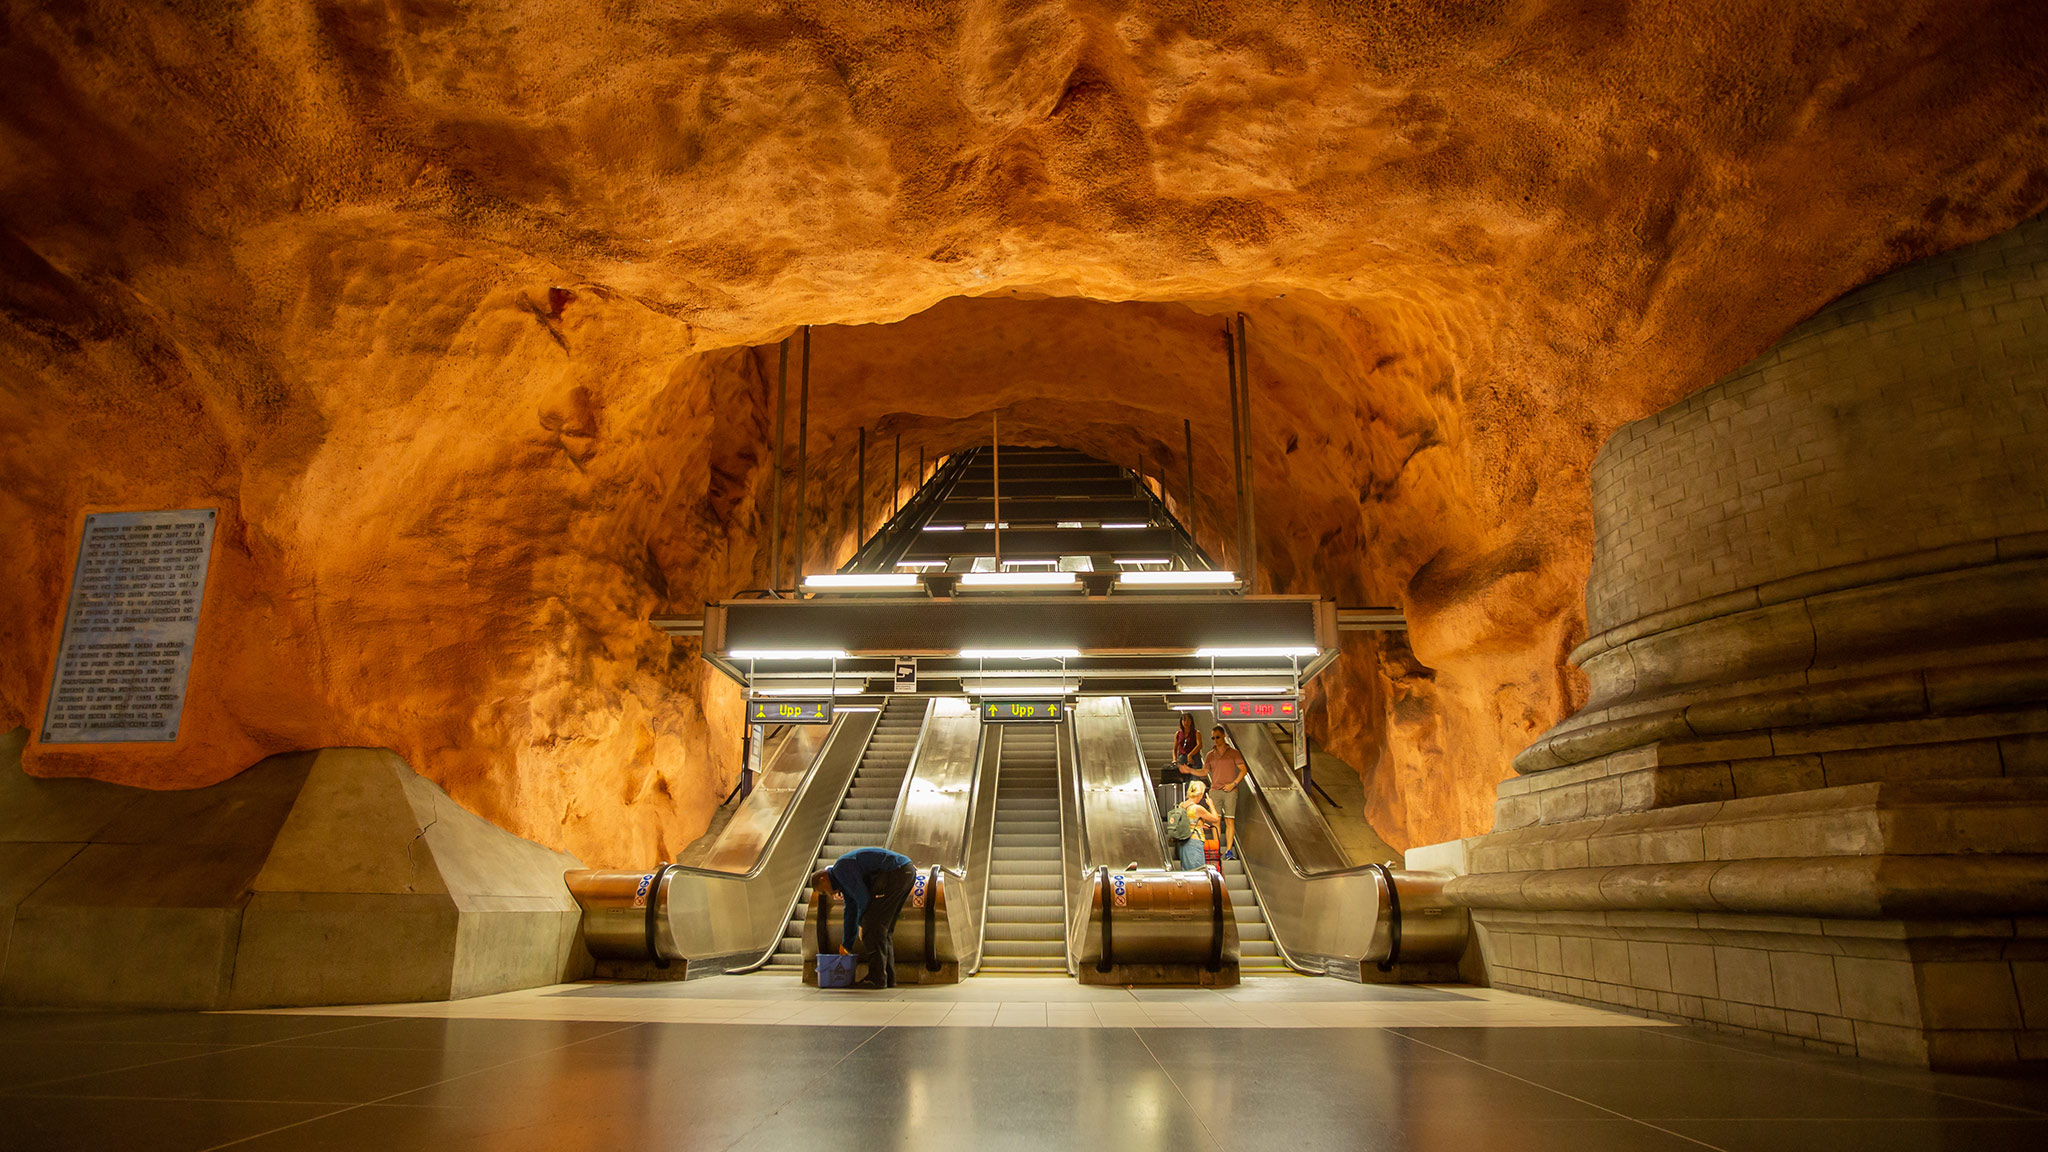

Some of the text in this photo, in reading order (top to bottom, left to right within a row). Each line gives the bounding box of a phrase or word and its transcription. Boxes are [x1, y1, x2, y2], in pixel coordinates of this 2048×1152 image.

[779, 704, 802, 718] Upp
[1011, 704, 1035, 718] Upp
[1239, 701, 1275, 717] Ej upp
